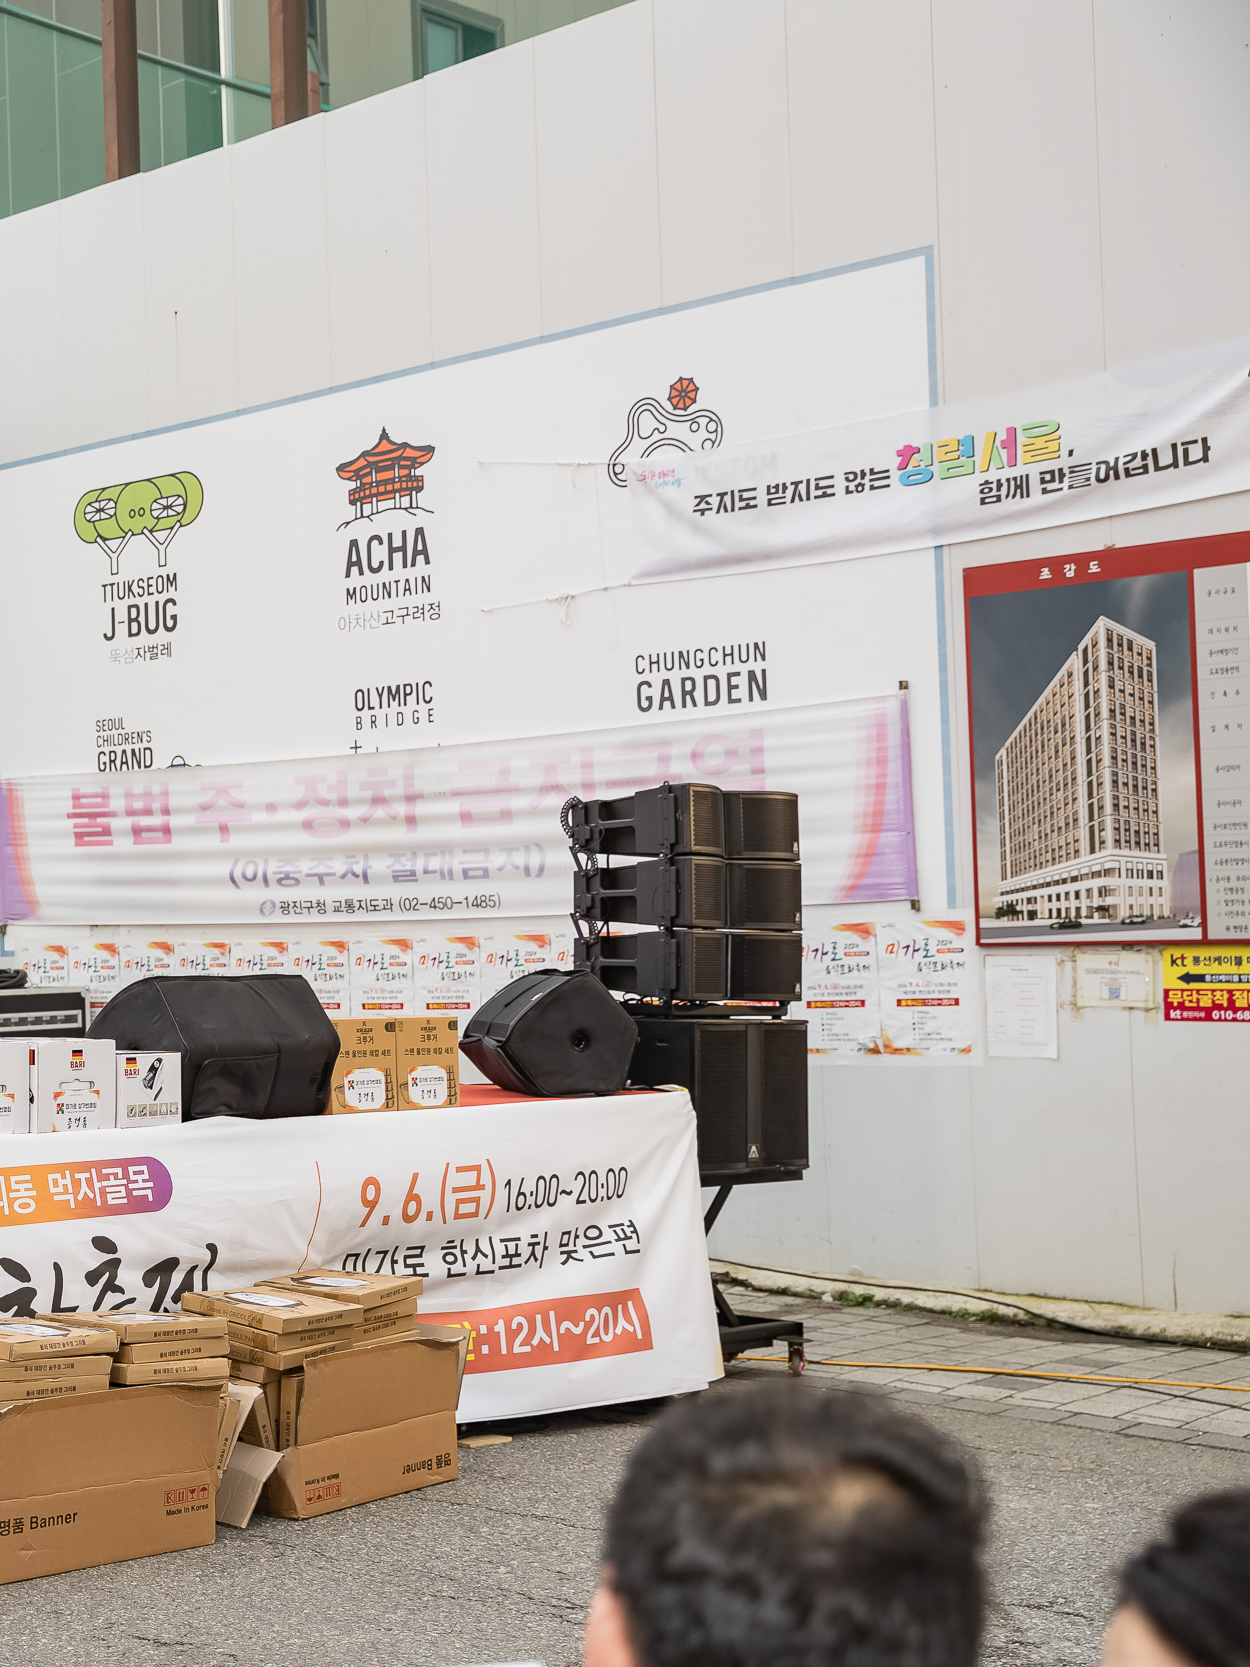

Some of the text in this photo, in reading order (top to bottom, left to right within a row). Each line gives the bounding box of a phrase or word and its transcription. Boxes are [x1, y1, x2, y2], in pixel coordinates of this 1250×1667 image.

[978, 436, 1212, 506] 함께 만들어갑니다
[693, 486, 758, 516] 주지도
[766, 474, 836, 507] 받지도
[844, 468, 891, 496] 않는
[344, 526, 431, 579] ACHA
[102, 573, 178, 603] TTUKSEOM
[346, 575, 432, 605] MOUNTAIN
[102, 598, 178, 642] J-BUG
[337, 601, 442, 632] 아차산고구려정
[109, 641, 172, 665] 뚝섬자벌레
[635, 641, 767, 675] CHUNGCHUN
[354, 680, 434, 712] OLYMPIC
[636, 669, 768, 713] GARDEN
[95, 718, 126, 733] SEOUL
[355, 708, 435, 731] BRIDGE
[96, 730, 152, 749] CHILDREN'S
[97, 747, 154, 772] GRAND
[66, 782, 173, 848] 불법
[228, 842, 547, 891] (이중주차 절대금지)
[279, 892, 502, 916] 광진구청 교통지도과 (02-450-1485)
[1170, 953, 1188, 967] kt
[1167, 990, 1229, 1008] 무단굴착
[1170, 1009, 1181, 1019] kt
[355, 1035, 374, 1045] 크루거
[420, 1034, 438, 1043] 크루거
[70, 1060, 86, 1069] BARI
[124, 1068, 140, 1078] BARI
[49, 1164, 155, 1209] 먹자골목
[504, 1166, 629, 1213] 16:00~20:00
[440, 1232, 549, 1279] 한신포차
[558, 1220, 641, 1266] 맞은편
[229, 1310, 250, 1323] GRIDDLE
[401, 1452, 452, 1476] 명품 Banner
[304, 1477, 320, 1486] Korea
[326, 1472, 340, 1481] Made
[29, 1509, 78, 1530] Banner
[165, 1506, 183, 1517] Made
[190, 1503, 209, 1513] Korea
